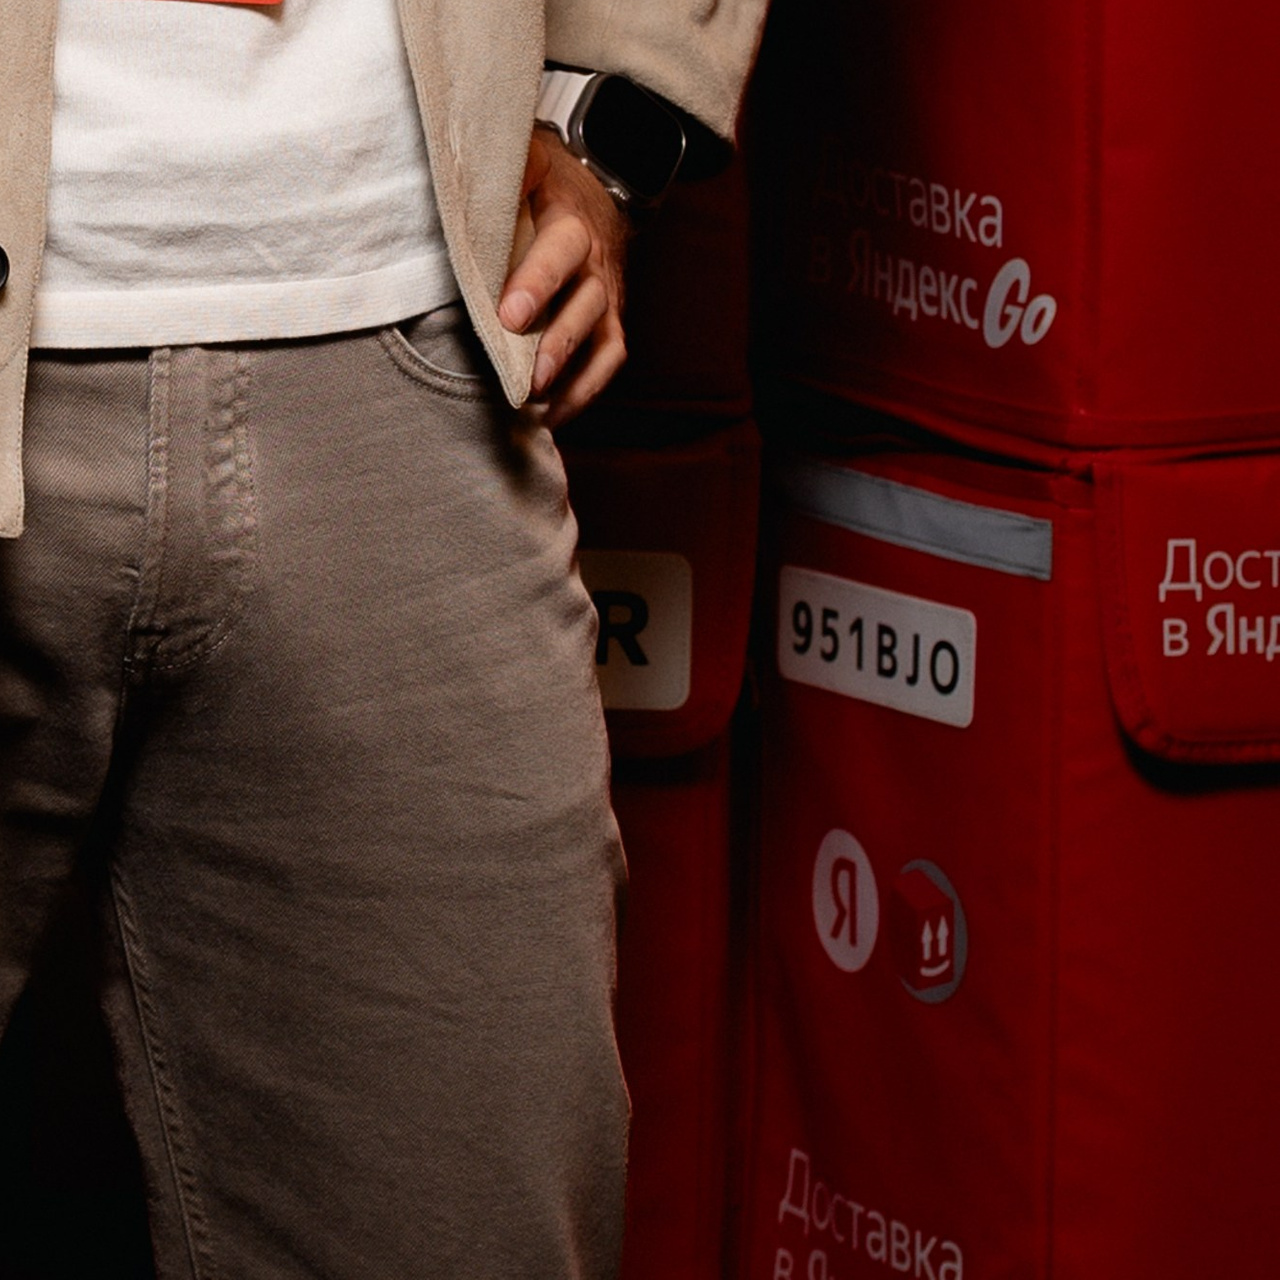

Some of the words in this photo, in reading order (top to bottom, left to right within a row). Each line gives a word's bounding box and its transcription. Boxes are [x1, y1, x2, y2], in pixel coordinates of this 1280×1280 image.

[981, 256, 1059, 350] Go
[792, 599, 960, 696] 951BJO
[1162, 617, 1189, 658] в
[776, 1147, 964, 1280] Доставка
